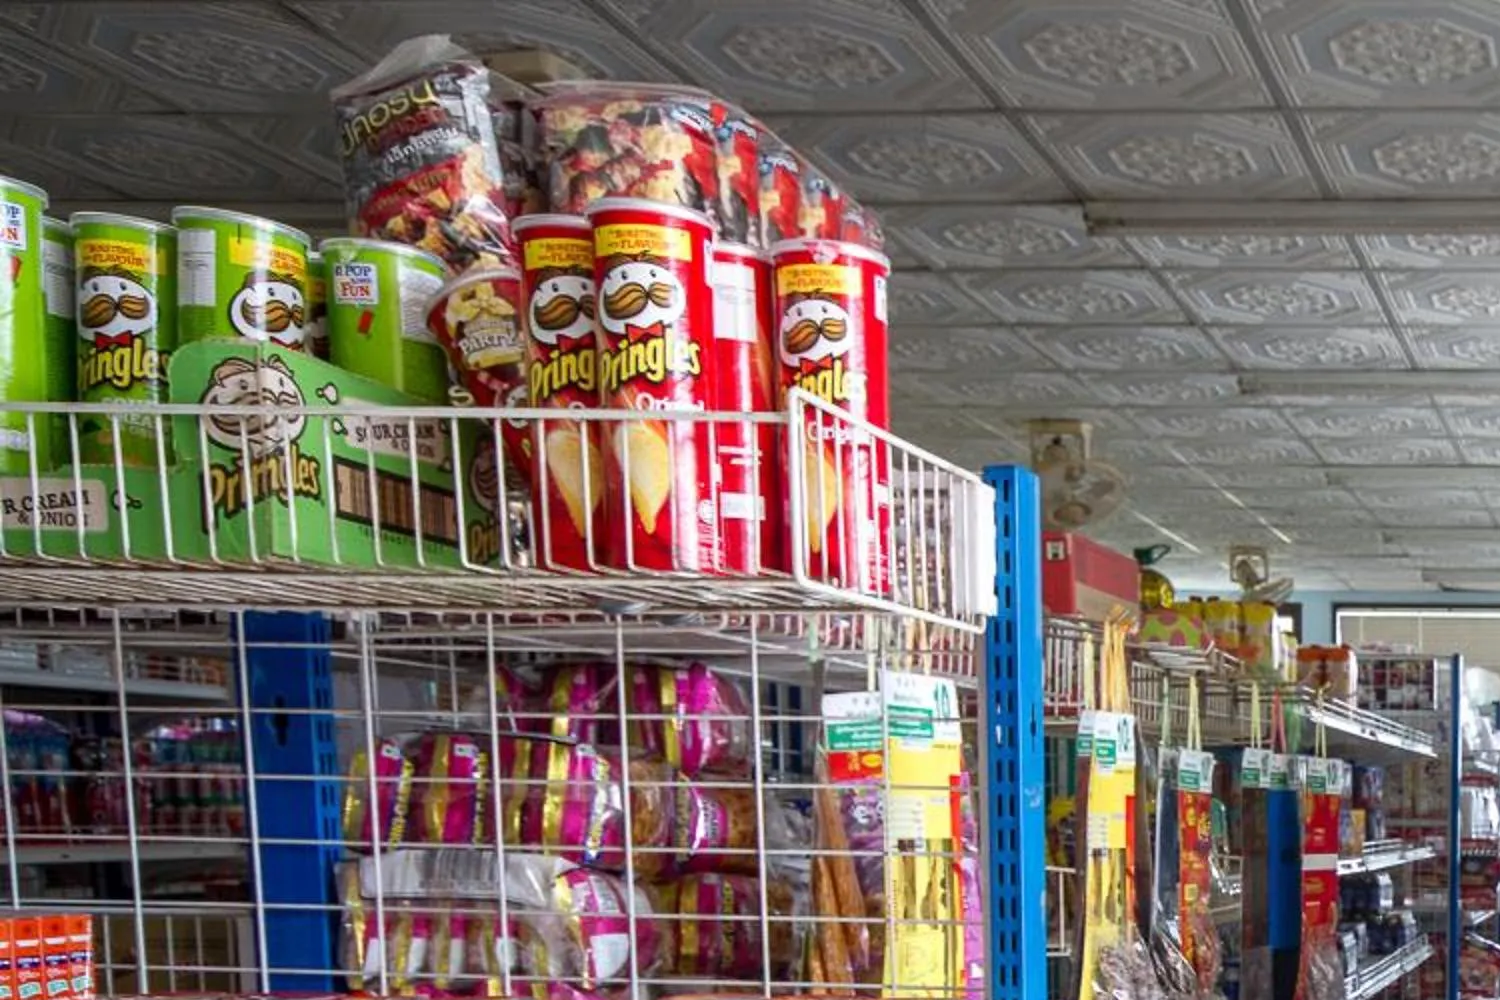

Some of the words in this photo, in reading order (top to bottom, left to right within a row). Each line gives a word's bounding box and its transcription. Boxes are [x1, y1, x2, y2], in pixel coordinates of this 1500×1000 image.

[339, 282, 371, 297] FUN
[345, 265, 372, 277] POP
[530, 347, 597, 407] Pring
[600, 326, 702, 404] Pringles
[795, 361, 868, 402] ingles
